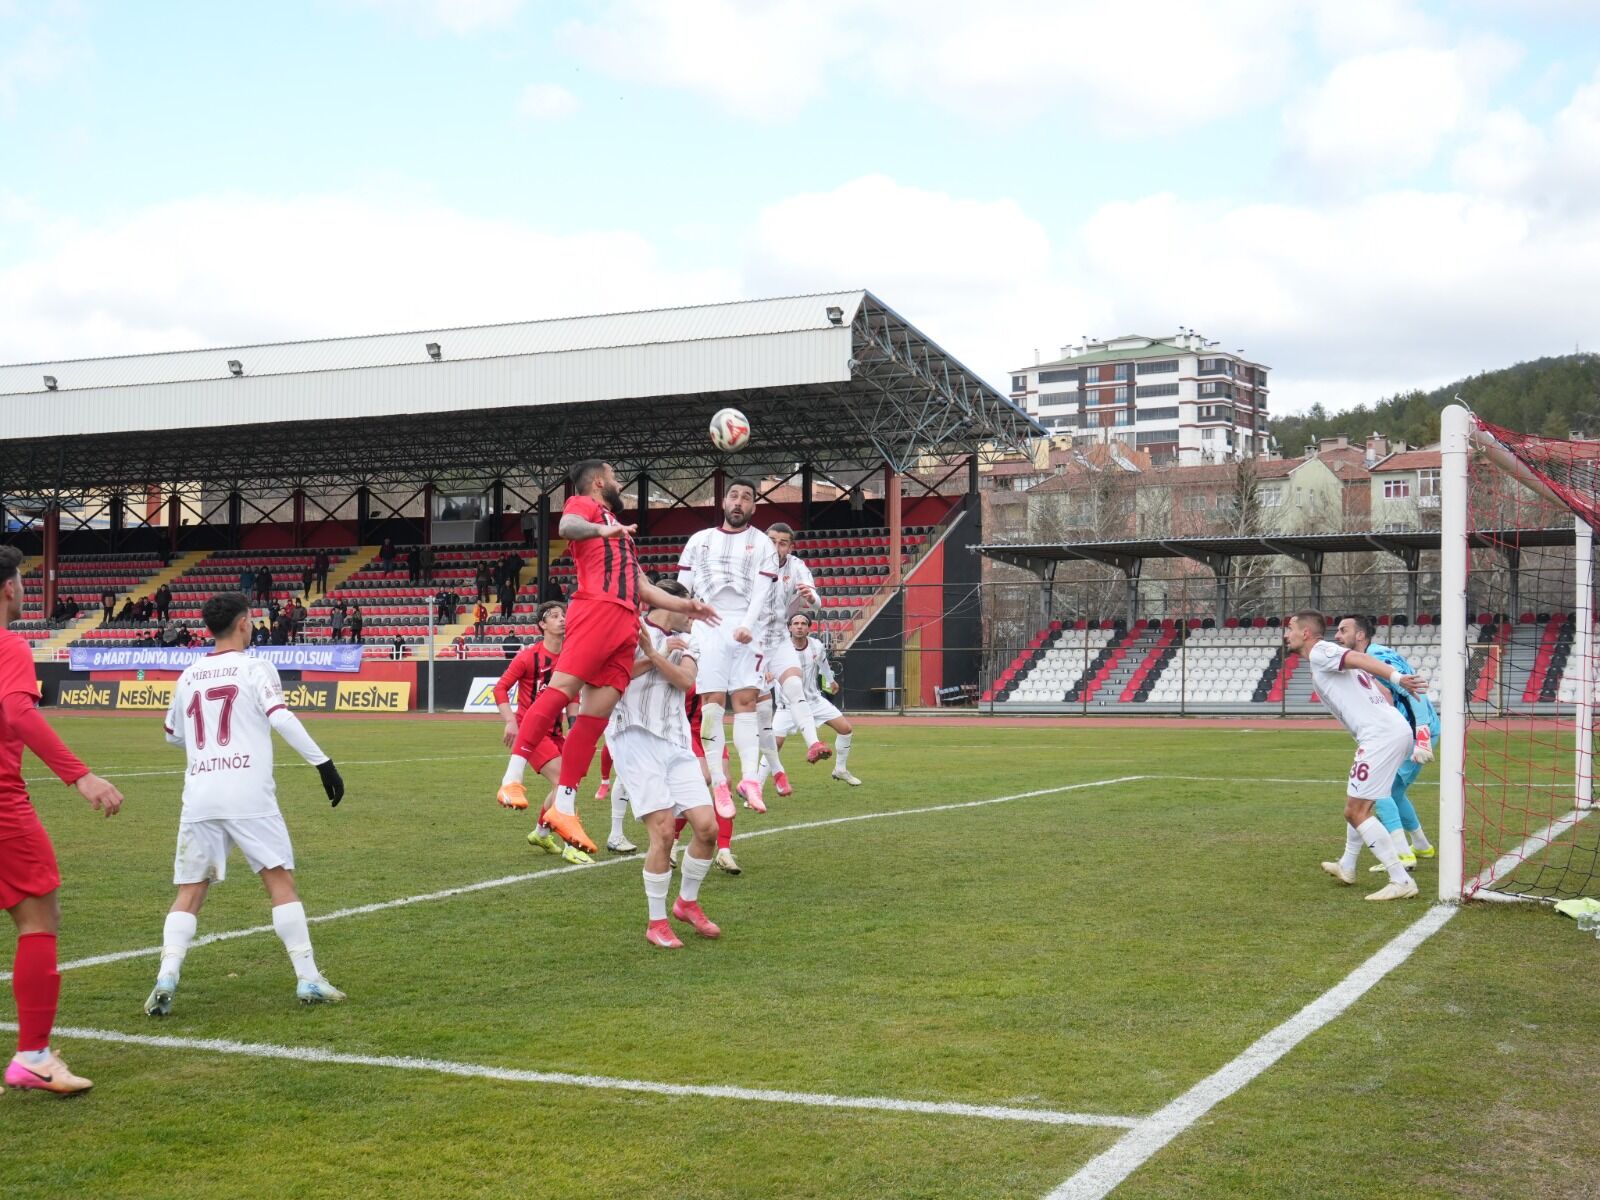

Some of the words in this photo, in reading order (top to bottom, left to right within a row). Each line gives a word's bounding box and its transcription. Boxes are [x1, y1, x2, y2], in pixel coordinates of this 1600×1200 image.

[93, 652, 100, 666] 8
[100, 651, 131, 665] MART
[133, 648, 168, 665] DÜNYA
[295, 650, 333, 666] OLSUN
[755, 653, 764, 672] 7
[187, 684, 239, 750] 17
[1349, 761, 1370, 782] 36
